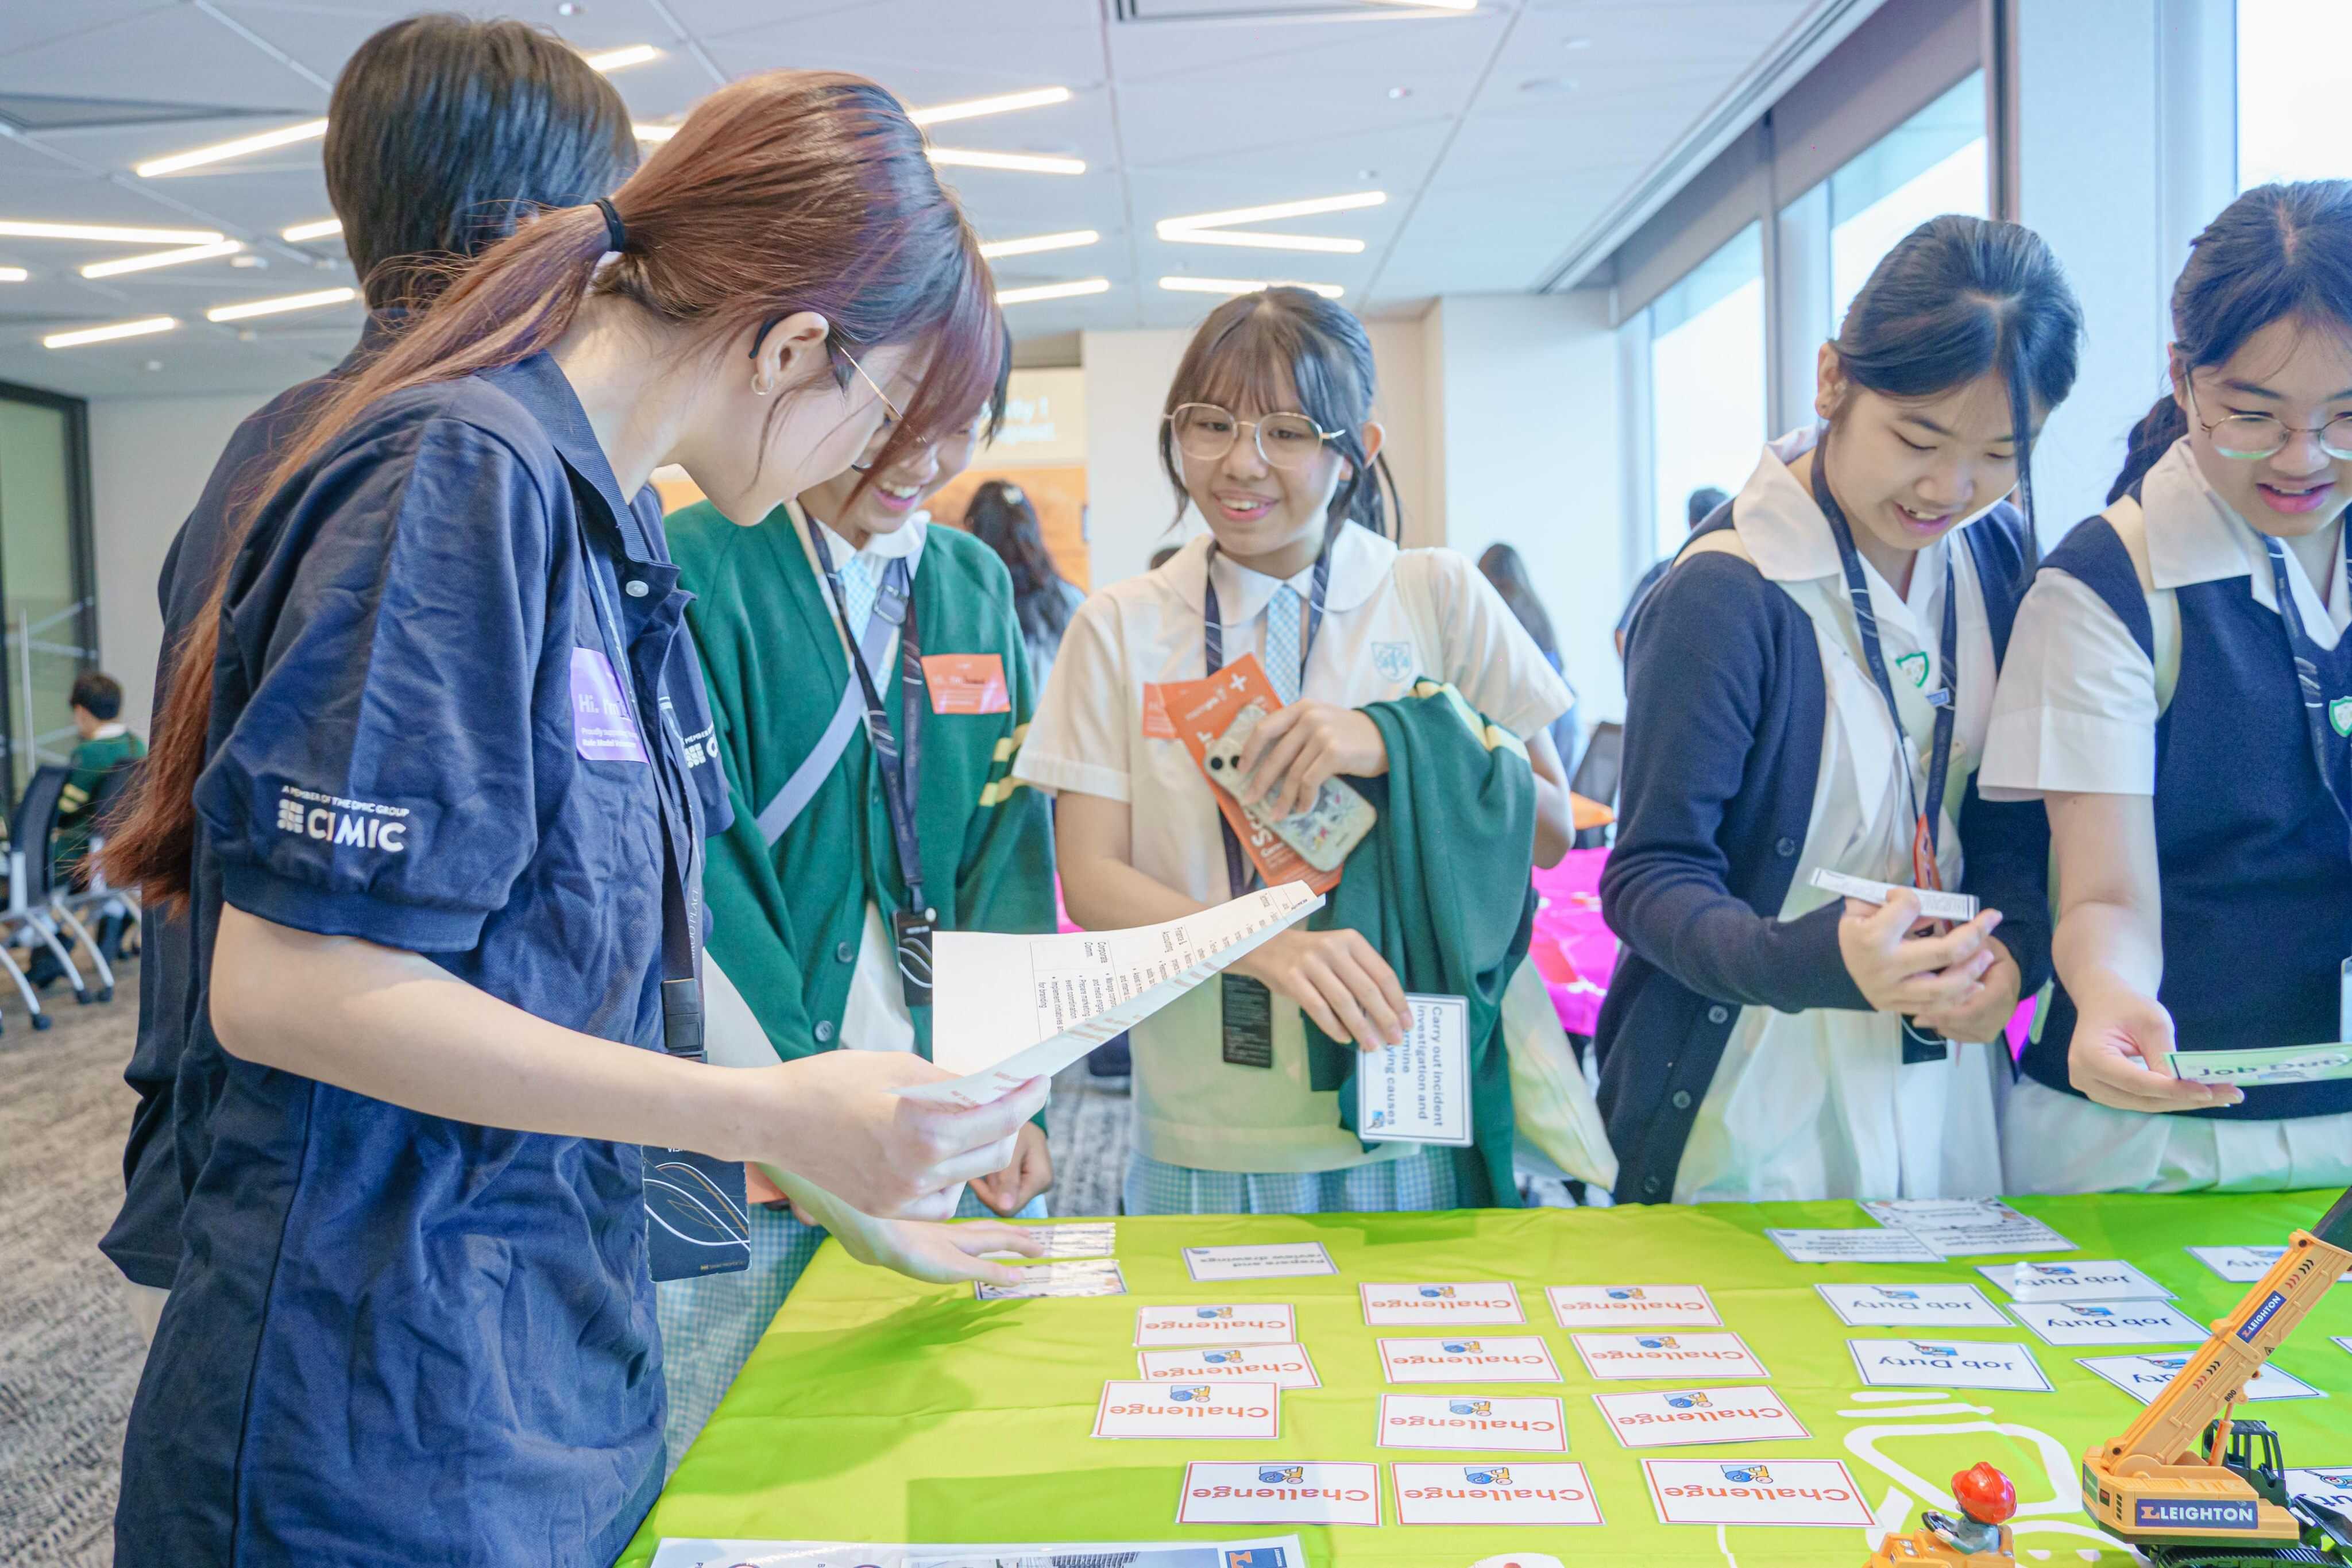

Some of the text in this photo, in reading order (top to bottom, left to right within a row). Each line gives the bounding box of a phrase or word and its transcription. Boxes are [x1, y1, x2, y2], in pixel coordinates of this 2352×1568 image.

[375, 805, 410, 817] GROUP
[307, 808, 407, 853] CIMIC
[689, 889, 699, 924] PLACE
[1097, 942, 1108, 963] Corporate
[1038, 989, 1048, 1009] branding
[1065, 980, 1078, 1019] event coordination
[1078, 979, 1091, 1017] Prepare marketing
[1415, 1005, 1428, 1120] investigation and
[1431, 1006, 1444, 1127] Carry out incident
[2199, 1067, 2257, 1076] Job
[1387, 1077, 1396, 1126] causes
[2227, 1258, 2279, 1268] uty
[2014, 1275, 2131, 1287] Job Duty
[1373, 1300, 1511, 1310] Challenge
[1561, 1301, 1704, 1311] Challenge
[1853, 1299, 1973, 1310] Job Duty
[2247, 1295, 2282, 1331] LEIGHTON
[1147, 1321, 1286, 1329] Challenge
[2048, 1317, 2172, 1328] Job Duty
[1393, 1353, 1547, 1365] Challenge
[1593, 1350, 1748, 1360] Challenge
[1878, 1356, 2014, 1371] Job Duty
[1153, 1364, 1303, 1377] Challenge
[2133, 1372, 2176, 1384] uty
[2224, 1389, 2237, 1402] 800
[1110, 1404, 1269, 1418] Challenge
[1618, 1407, 1785, 1426] Challenge
[1392, 1418, 1554, 1431] Challenge
[1194, 1487, 1369, 1501] Challenge
[1406, 1489, 1584, 1501] Challenge
[1666, 1485, 1850, 1501] Challenge
[2160, 1505, 2254, 1522] LEIGHTON
